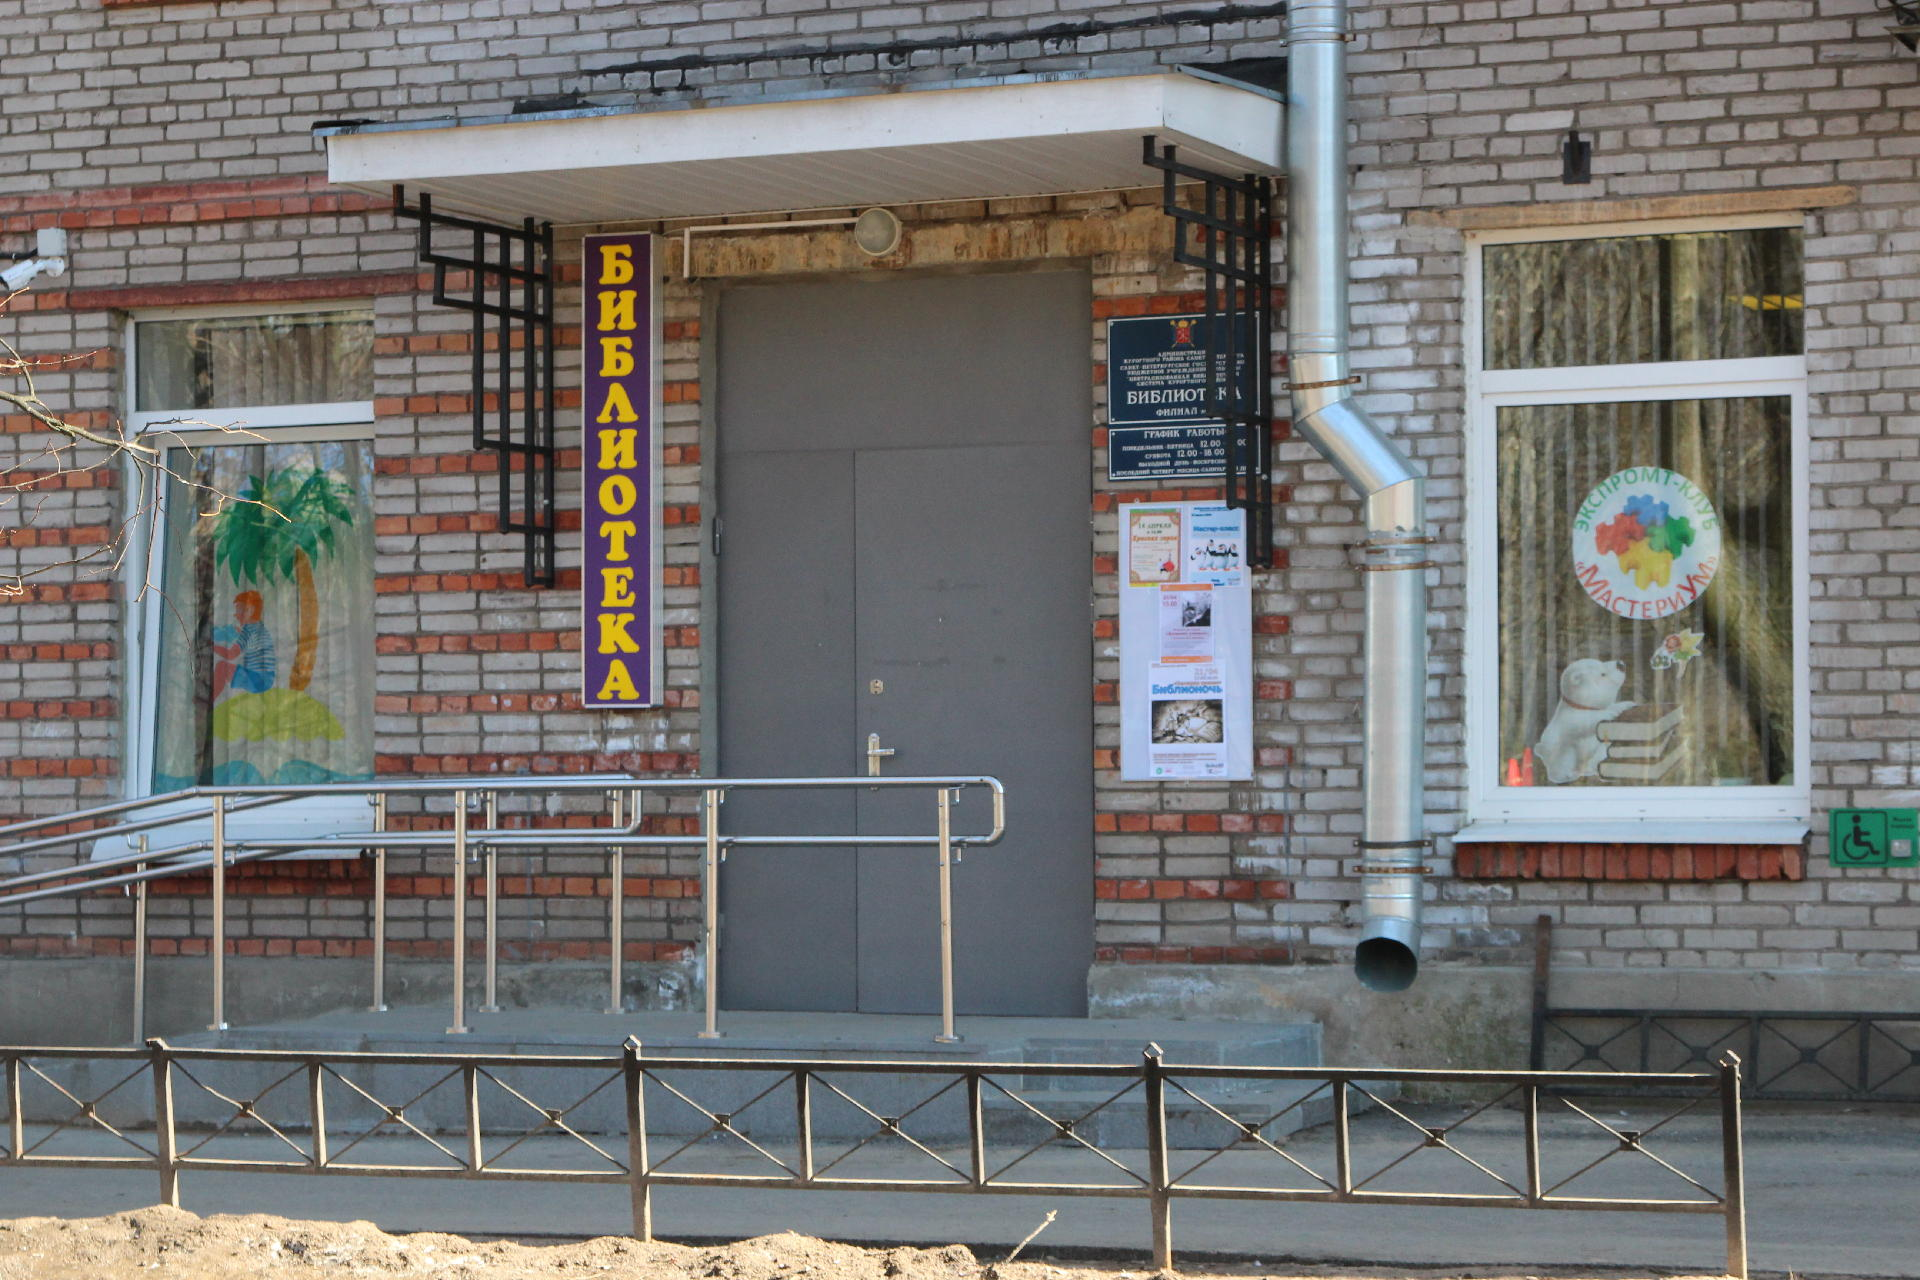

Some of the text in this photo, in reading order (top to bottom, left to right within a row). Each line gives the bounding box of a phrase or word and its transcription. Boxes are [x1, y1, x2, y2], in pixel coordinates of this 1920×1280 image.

[1127, 386, 1242, 405] БИБЛИОТК
[1156, 407, 1198, 416] ФИЛИАЛ
[1144, 428, 1225, 439] ГРАФИК РАБОТЫ
[596, 244, 640, 701] БИБЛИОТЕКА
[1575, 467, 1718, 533] ЭКСПРОМТ-КЛУБ
[1152, 684, 1223, 695] Библионочь
